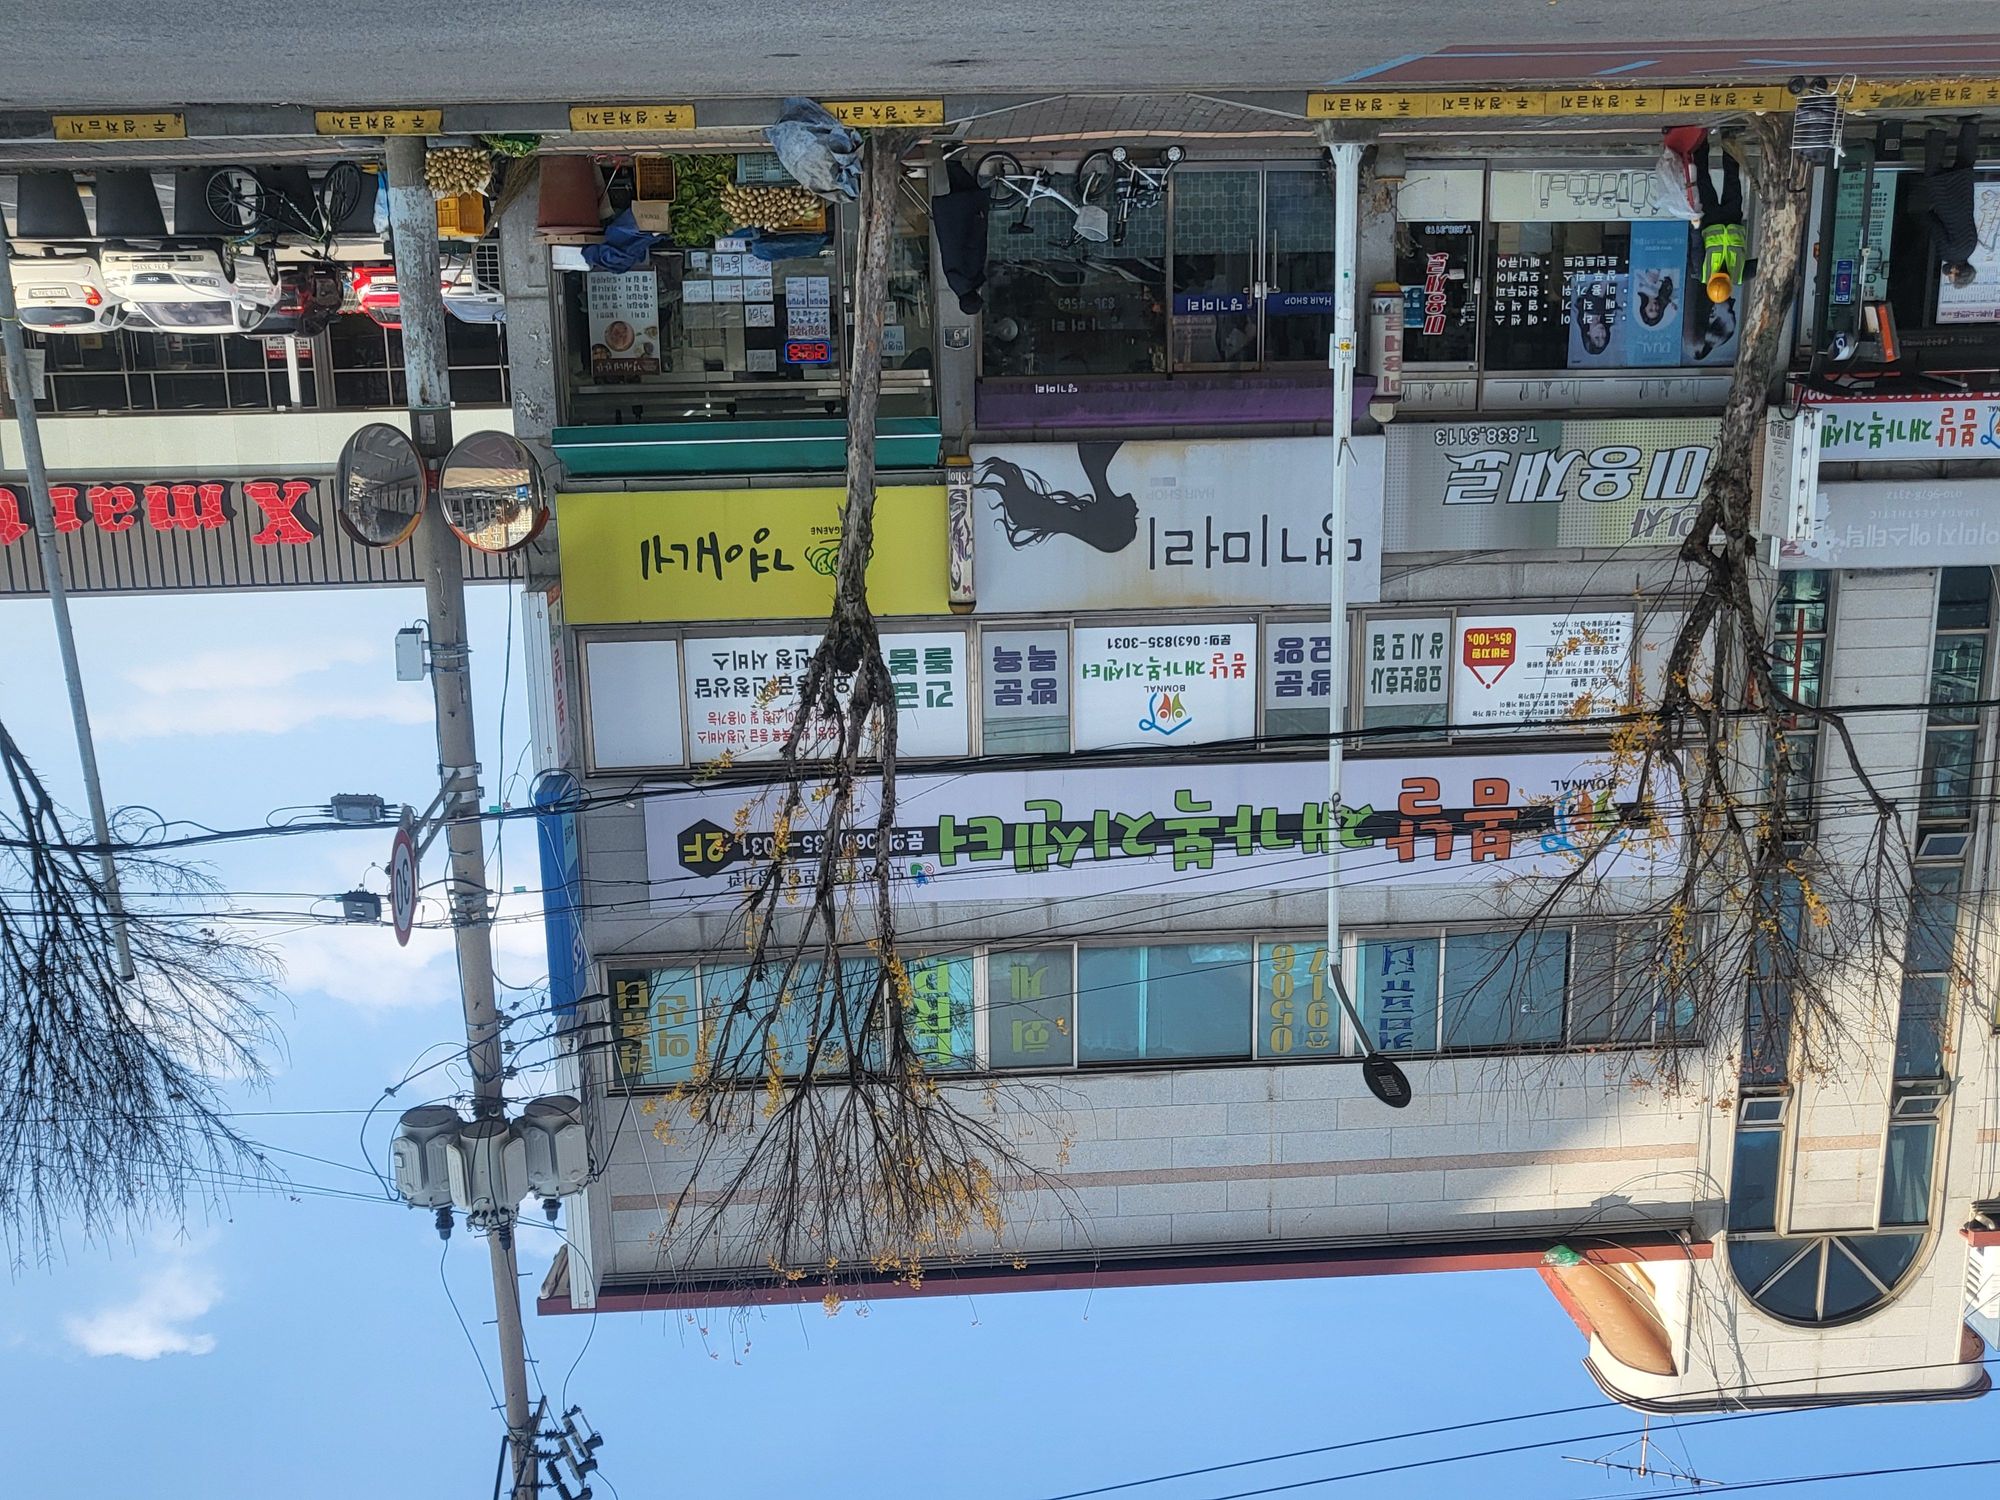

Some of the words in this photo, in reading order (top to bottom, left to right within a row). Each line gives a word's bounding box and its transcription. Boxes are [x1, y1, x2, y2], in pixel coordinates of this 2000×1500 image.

[1495, 270, 1540, 283] 모발케어
[1186, 297, 1243, 312] 댕기머리
[1284, 296, 1308, 306] SHOP
[1309, 296, 1332, 306] HAIR
[1422, 251, 1450, 336] 미용재료
[1034, 382, 1078, 394] 댕기머리
[1434, 425, 1537, 445] T.838.3113
[1819, 410, 1933, 449] 재가복지센
[1935, 407, 1978, 448] 봄날
[1442, 445, 1712, 505] 미용재료
[1148, 512, 1363, 571] 댕기머리
[1846, 523, 1931, 549] 에스테틱
[1937, 522, 1999, 547] 이미지
[640, 527, 795, 583] 경애네
[1106, 634, 1201, 650] 063)835-3031
[1273, 636, 1331, 664] 요양
[1372, 632, 1444, 661] 상시모집
[711, 649, 768, 672] 서비스
[888, 648, 954, 676] 돌봄
[992, 644, 1057, 673] 목욕
[1081, 655, 1205, 682] 재가복지센터
[1209, 652, 1248, 680] 봄날
[694, 676, 768, 699] 신청상담
[993, 677, 1057, 707] 방문
[1143, 684, 1186, 693] BOMNAL
[1274, 669, 1331, 698] 방문
[1370, 665, 1442, 695] 요양보호사
[892, 681, 954, 709] 긴급
[707, 711, 747, 726] 이용가능
[696, 729, 747, 744] 신청서비스
[749, 728, 769, 743] 등급
[1550, 778, 1616, 791] BOMNAL
[937, 789, 1375, 874] 재가복지센터
[1385, 778, 1518, 864] 봄날
[684, 831, 725, 863] 2F
[395, 859, 410, 916] 30
[1009, 964, 1052, 1055] 회계
[1269, 944, 1295, 1054] 0506
[1378, 944, 1415, 1050] 컴퓨터
[657, 995, 690, 1058] 익산
